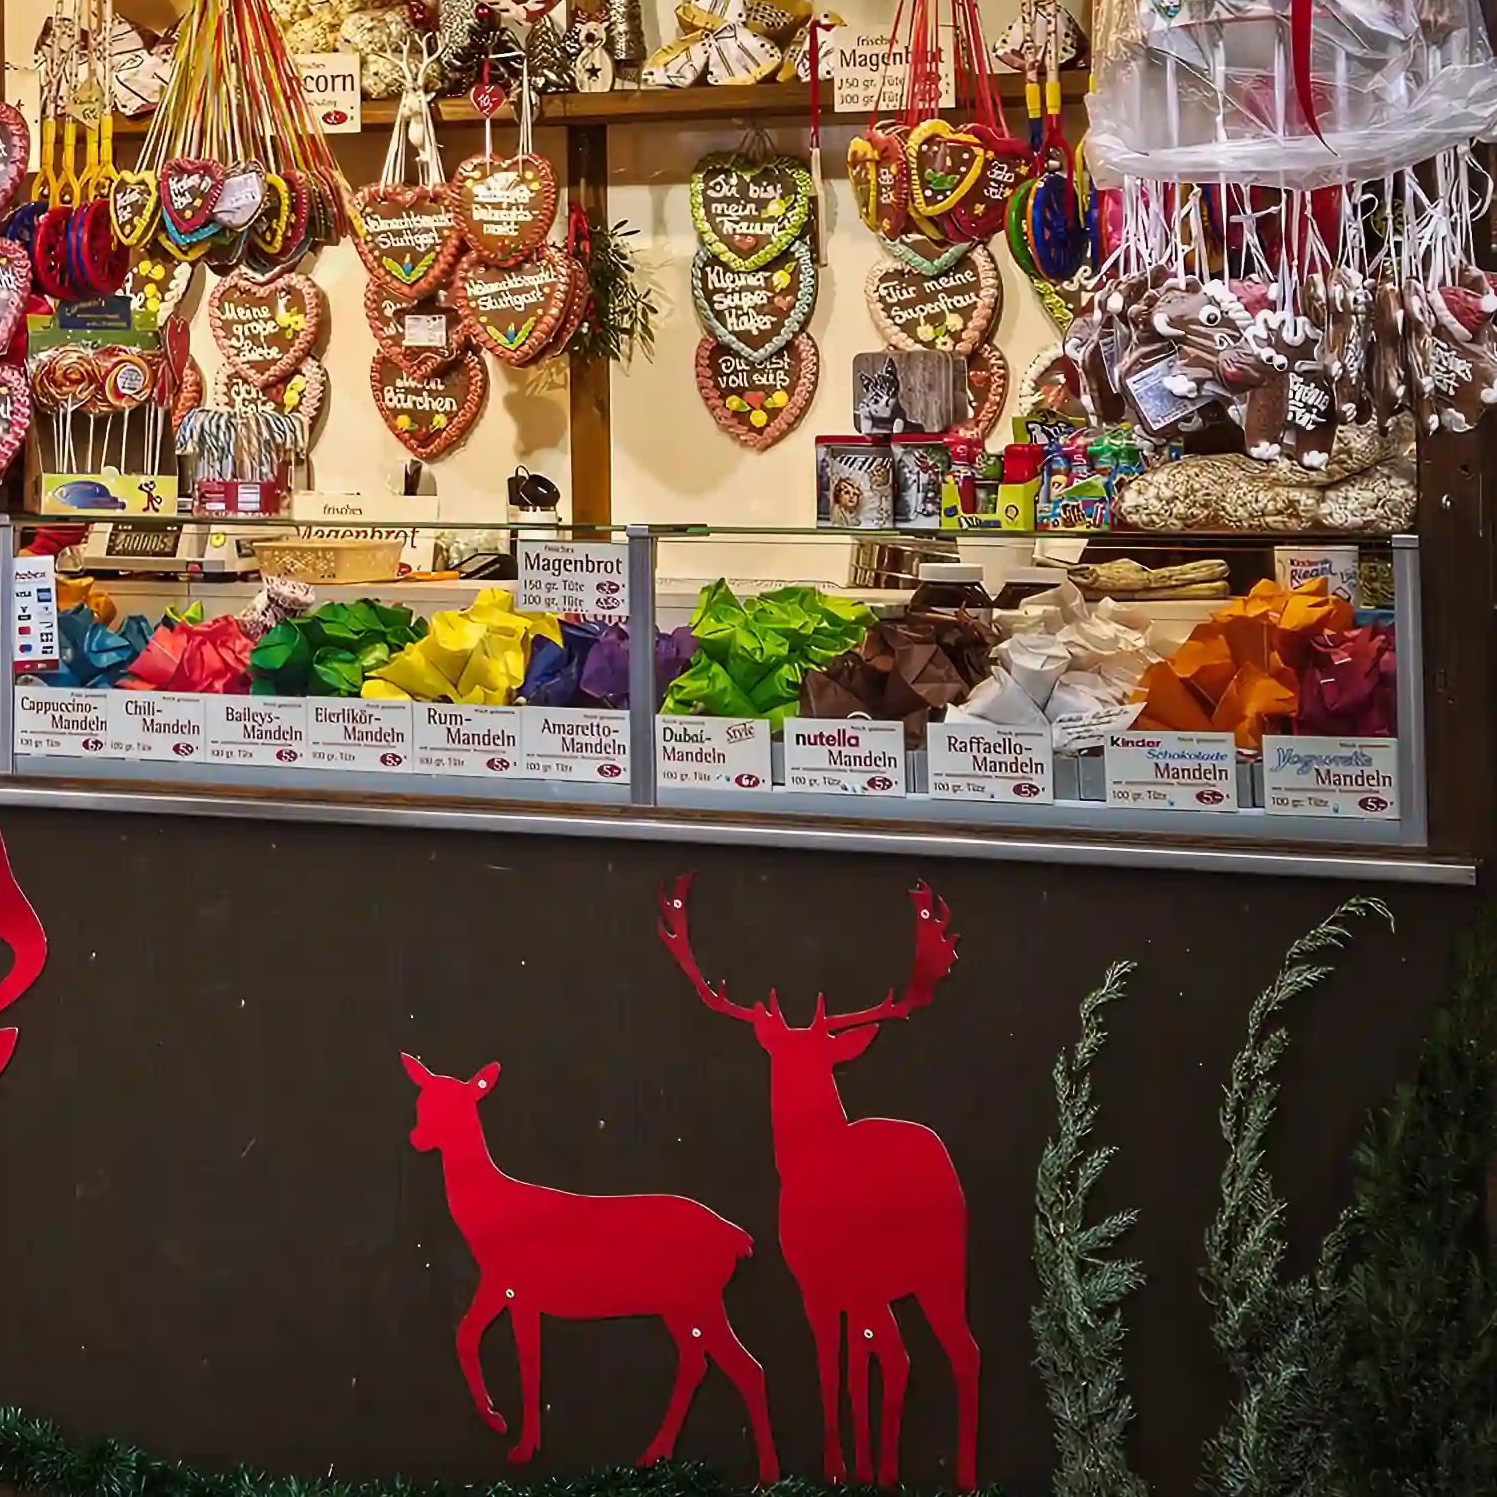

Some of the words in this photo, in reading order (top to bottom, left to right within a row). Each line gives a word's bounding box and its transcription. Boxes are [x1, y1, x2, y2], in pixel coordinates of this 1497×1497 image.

[857, 35, 898, 47] frischs
[839, 46, 944, 72] Magent
[302, 73, 355, 96] corn
[748, 175, 782, 199] bist
[711, 201, 759, 216] mein
[716, 215, 781, 238] Traum
[705, 266, 770, 289] Kleiner
[878, 280, 917, 303] Für
[924, 269, 977, 293] meine
[220, 301, 271, 320] Meine
[891, 292, 982, 324] Superfrau
[725, 310, 777, 336] Käfer
[718, 370, 748, 388] voll
[752, 370, 791, 387] süß
[384, 387, 457, 412] Bärchen
[524, 551, 622, 577] Magenbrot
[523, 579, 542, 591] 150
[562, 579, 585, 592] Tüte
[21, 696, 99, 715] Cappuccino-
[124, 700, 163, 716] Chili-
[51, 714, 107, 731] Mandeln
[142, 717, 200, 735] Mandeln
[225, 706, 281, 728] Baileys-
[315, 706, 382, 727] Eierlikör-
[427, 707, 473, 727] Rum-
[243, 723, 303, 742] Mandeln
[343, 724, 405, 744] Mandeln
[446, 728, 516, 748] Mandeln
[541, 718, 620, 739] Amaretto-
[662, 726, 712, 744] Dubai-
[795, 729, 861, 748] nutella
[561, 737, 627, 756] Mandeln
[662, 745, 727, 764] Mandeln
[947, 735, 1033, 755] Raffaello-
[1145, 748, 1229, 761] Schokolade
[827, 749, 898, 768] Mandeln
[972, 755, 1045, 775] Mandeln
[1154, 762, 1229, 781] Mandeln
[1315, 768, 1393, 788] Mandeln
